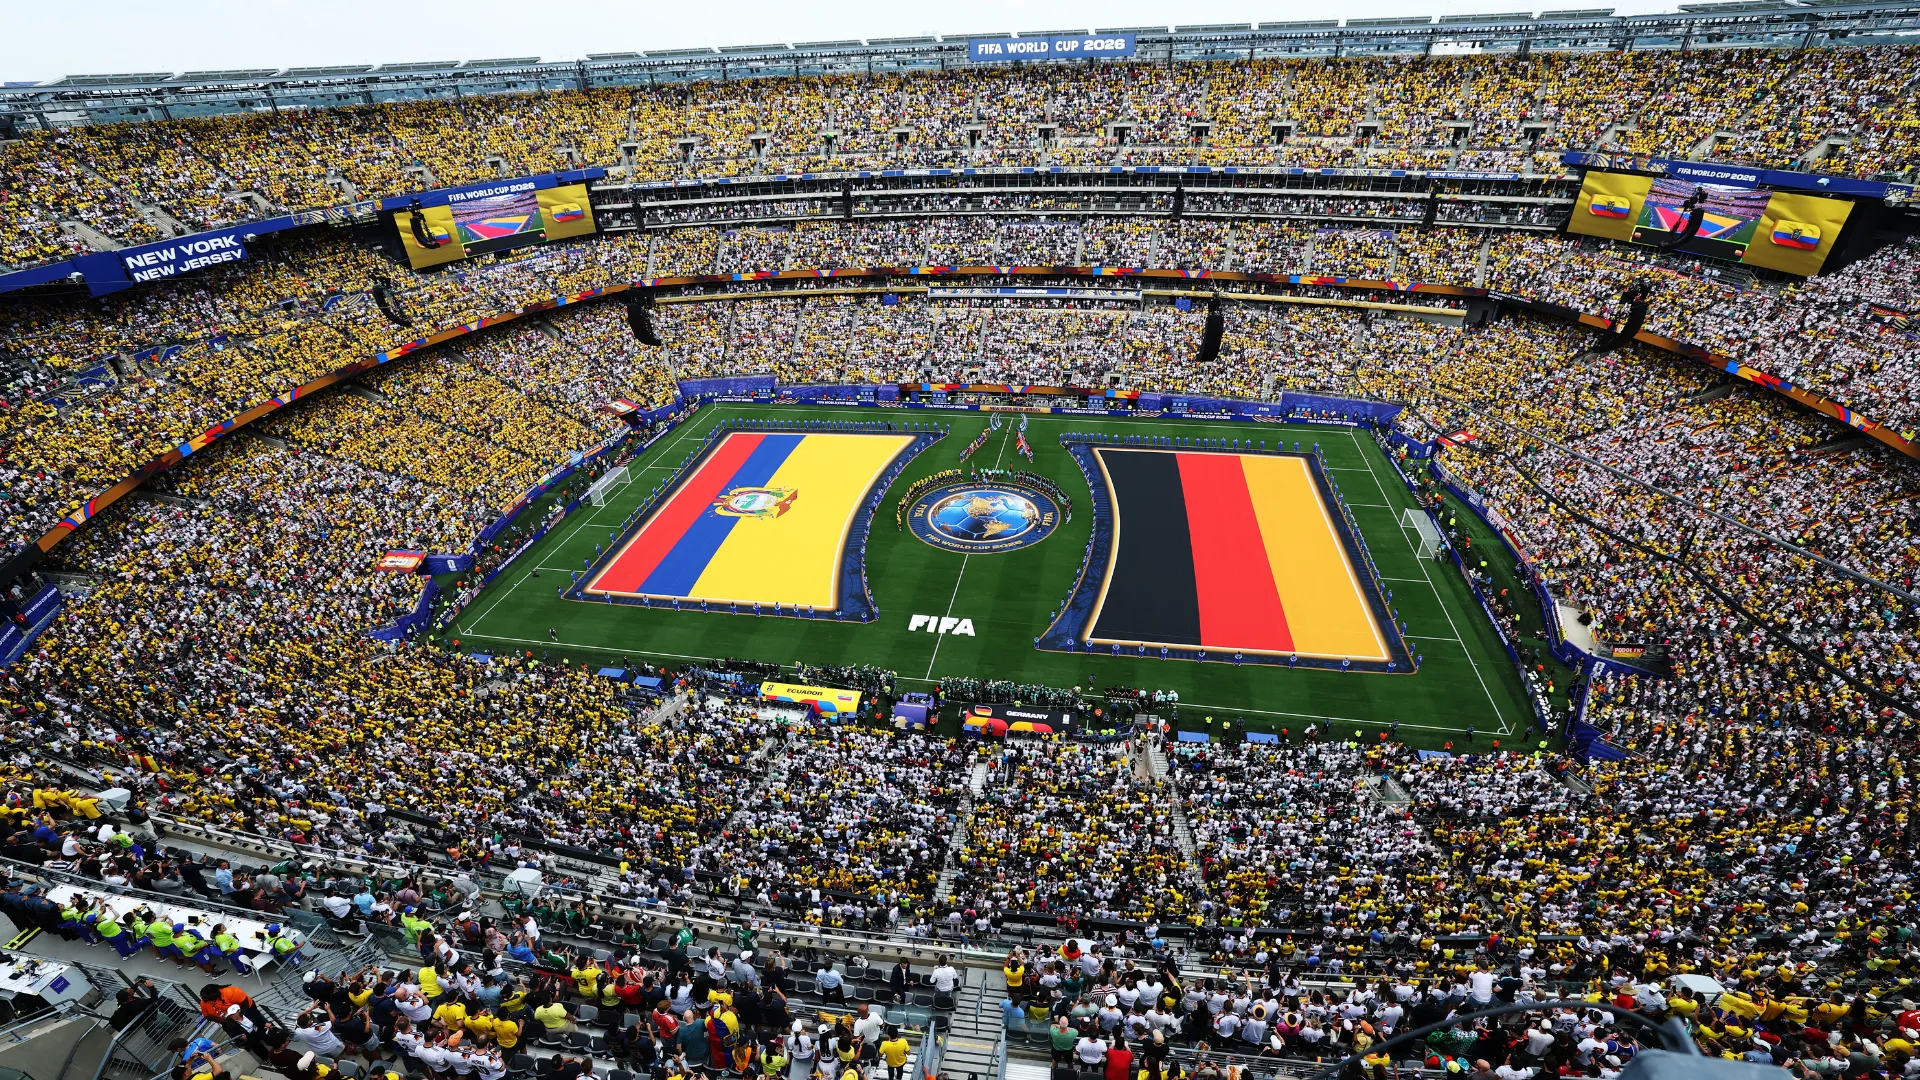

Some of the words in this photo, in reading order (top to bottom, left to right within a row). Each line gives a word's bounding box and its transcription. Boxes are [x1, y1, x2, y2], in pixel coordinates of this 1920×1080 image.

[978, 44, 1003, 54] FIFA
[1007, 42, 1048, 54] WORLD
[1055, 40, 1079, 51] CUP
[1084, 39, 1126, 50] 2026
[448, 194, 466, 202] FIFA
[466, 190, 494, 199] WORLD
[494, 187, 509, 195] CUP
[510, 182, 535, 192] 2026
[125, 248, 176, 269] NEW
[179, 235, 239, 256] YORK
[134, 264, 175, 282] NEW
[179, 249, 242, 272] JERSEY
[1042, 511, 1054, 527] FIFA
[926, 533, 942, 543] FIFA
[942, 540, 971, 550] WORLD
[908, 614, 975, 636] FIFA
[786, 688, 823, 696] ECUADOR
[1006, 710, 1048, 720] GERMANY
